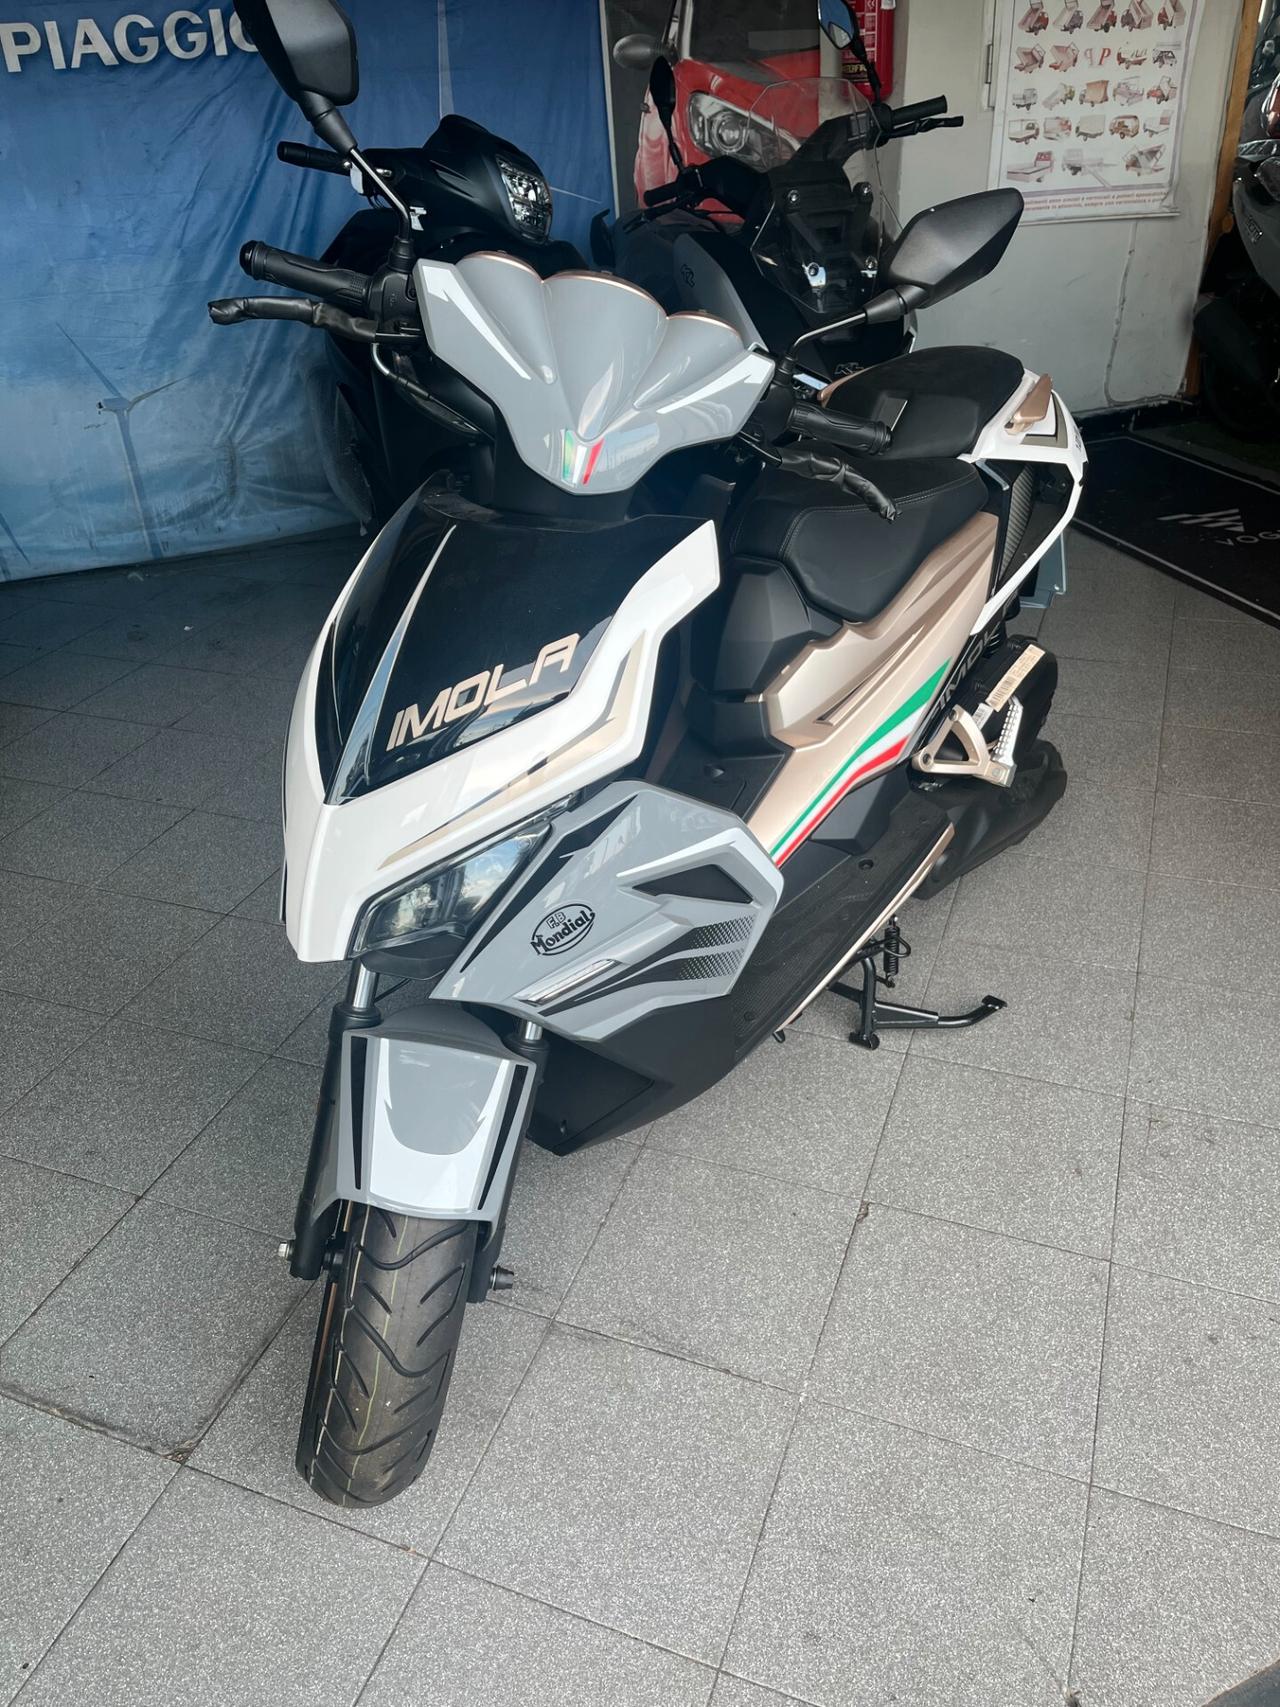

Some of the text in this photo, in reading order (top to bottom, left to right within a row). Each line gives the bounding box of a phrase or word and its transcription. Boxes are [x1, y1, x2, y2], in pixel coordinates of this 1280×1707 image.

[1214, 530, 1280, 547] VOG
[386, 632, 580, 751] IMOLA
[530, 910, 595, 955] Mondial
